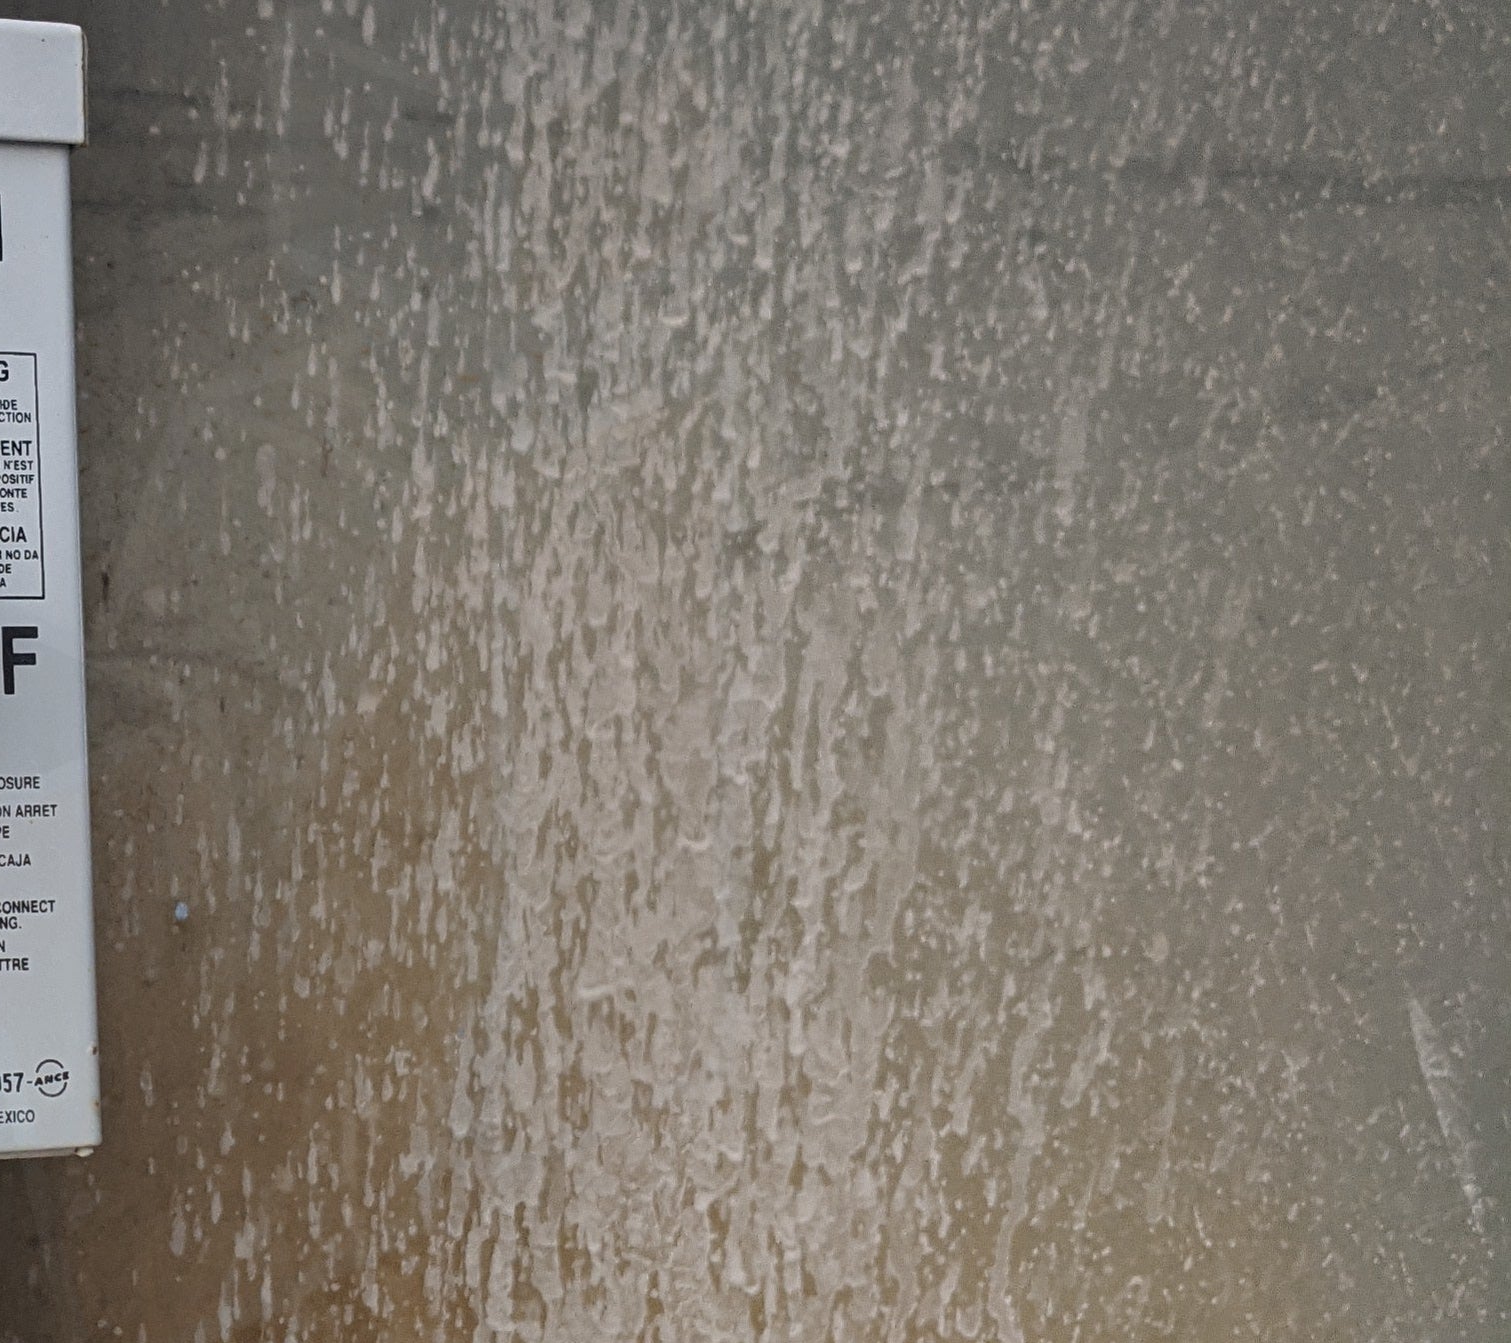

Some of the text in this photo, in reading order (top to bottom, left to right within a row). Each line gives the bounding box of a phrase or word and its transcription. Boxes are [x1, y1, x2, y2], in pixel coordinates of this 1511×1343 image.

[3, 459, 34, 471] N'EST
[5, 549, 21, 560] NO
[24, 549, 39, 560] DA
[15, 804, 58, 818] ARRET
